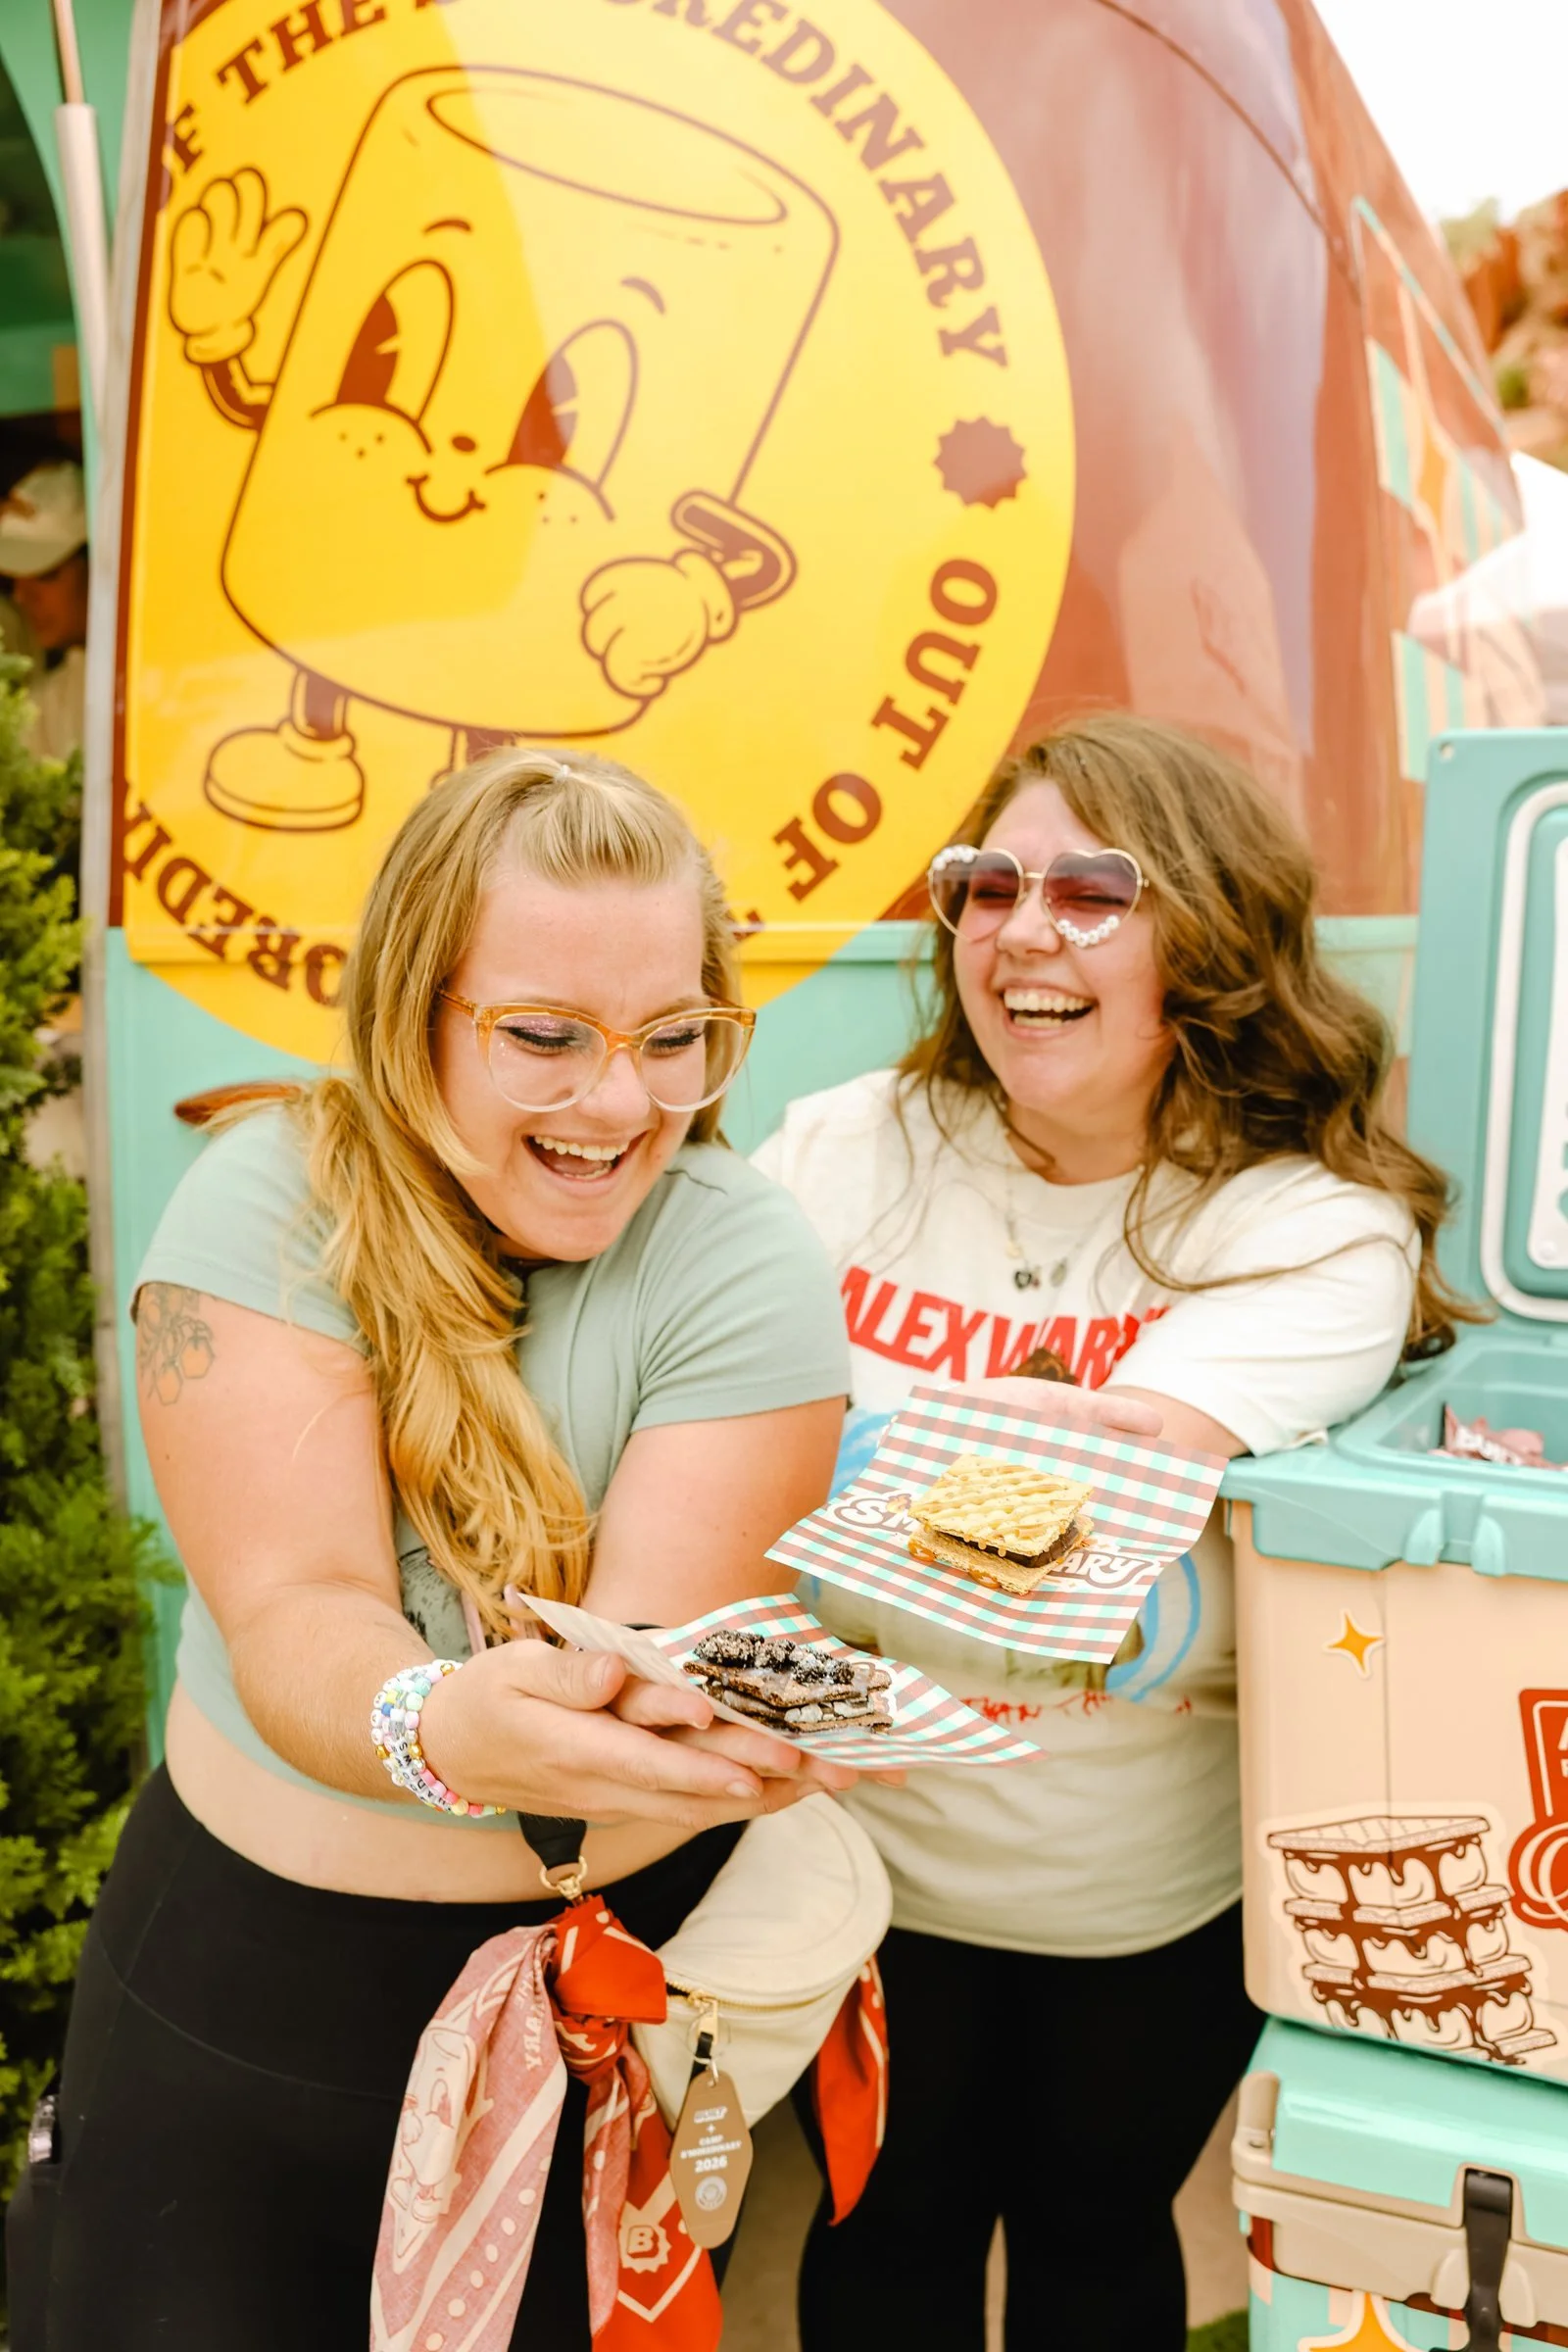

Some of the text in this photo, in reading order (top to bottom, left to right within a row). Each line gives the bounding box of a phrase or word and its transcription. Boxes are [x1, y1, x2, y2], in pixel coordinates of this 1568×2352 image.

[772, 559, 998, 904] OUT OF
[628, 2226, 659, 2258] B
